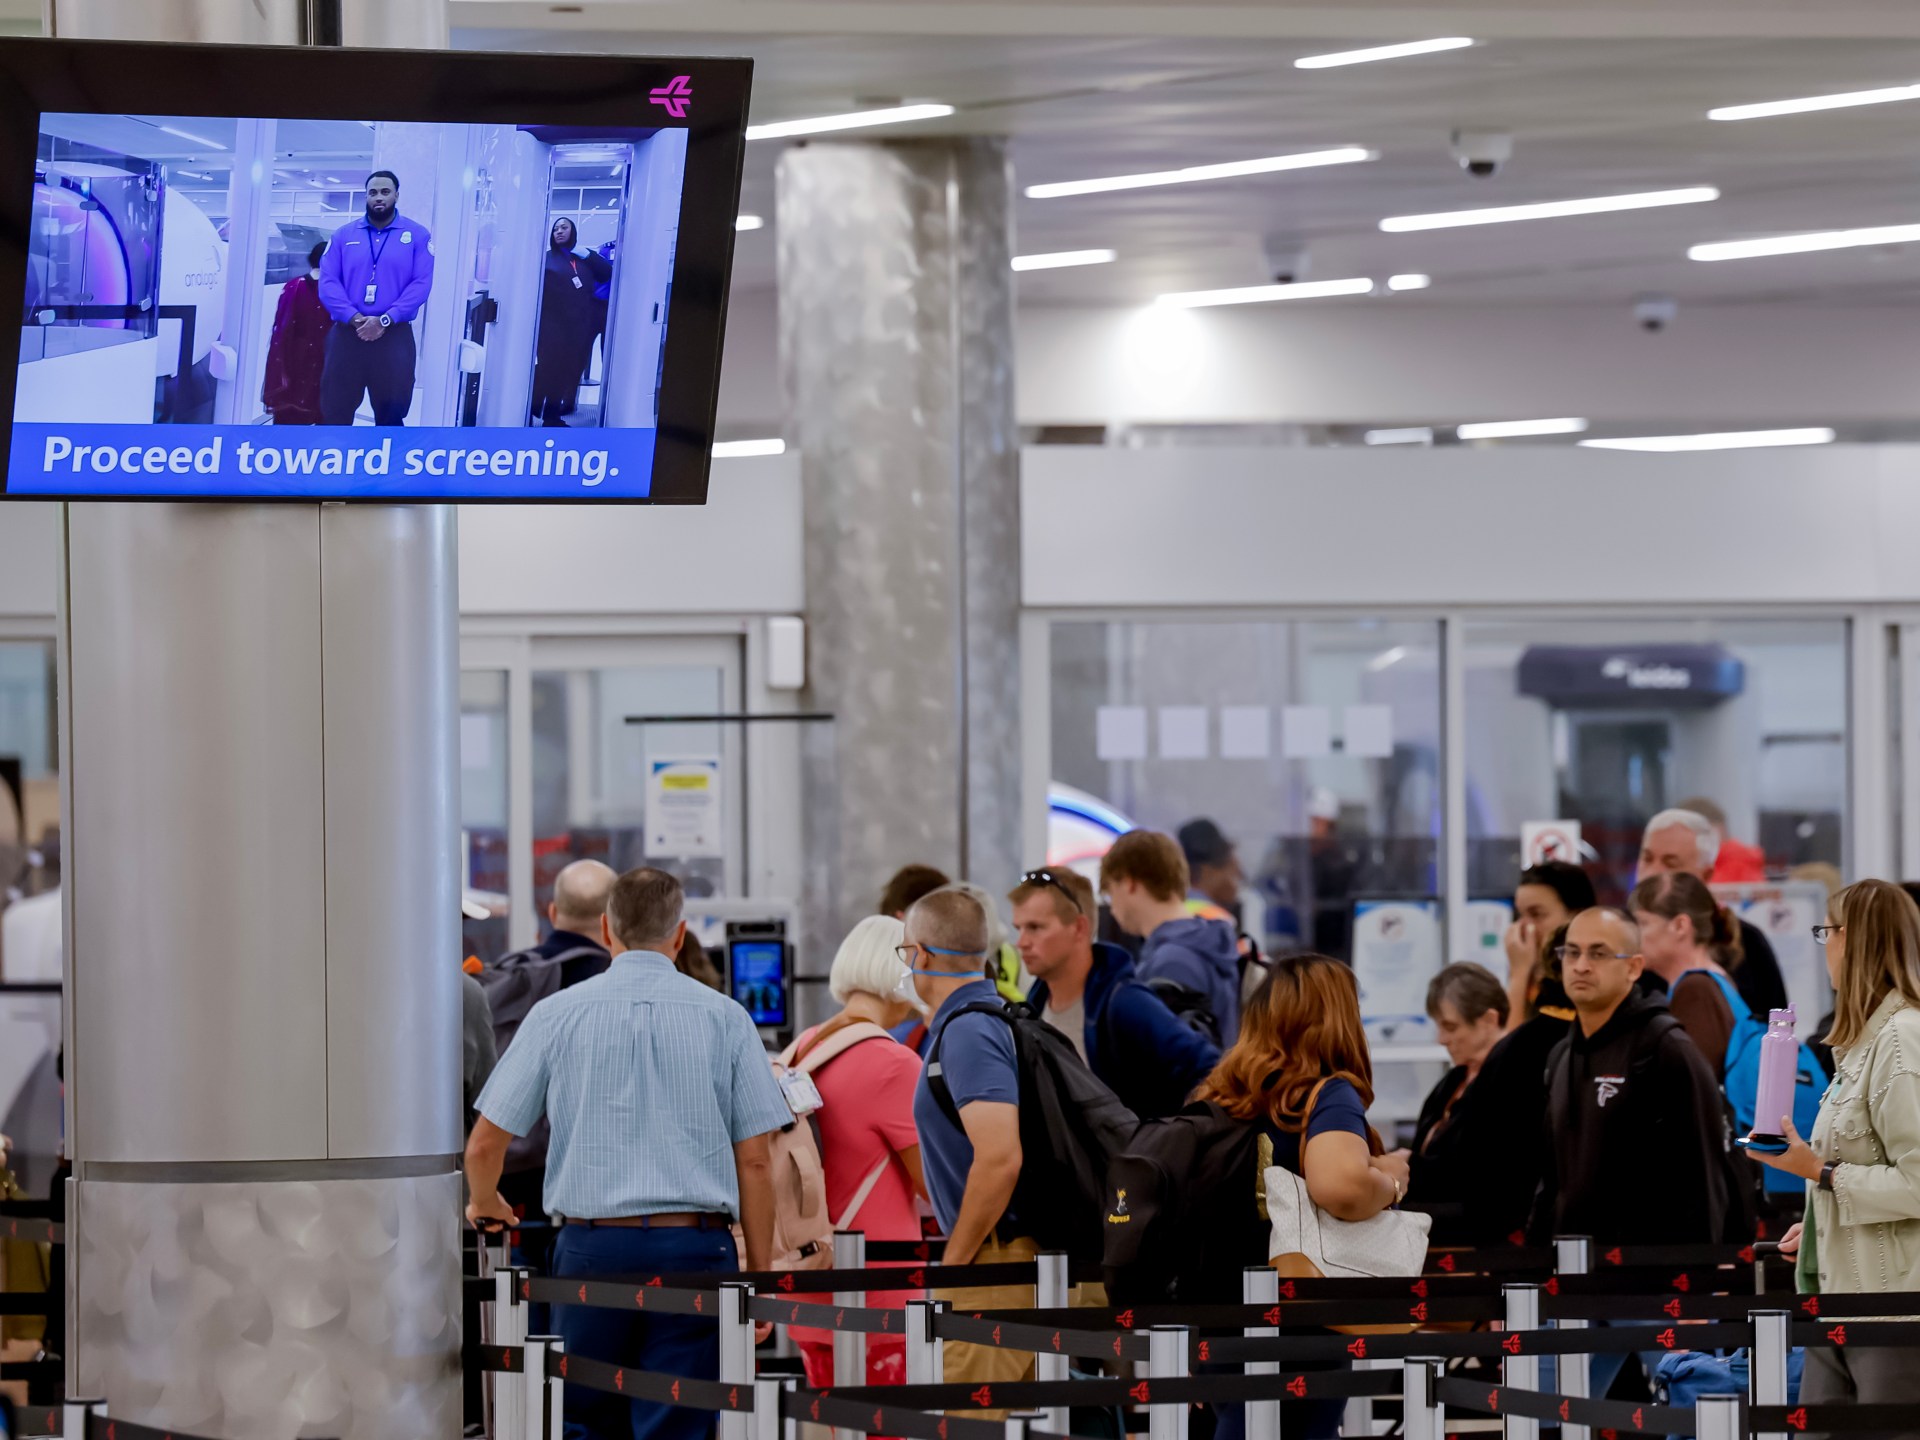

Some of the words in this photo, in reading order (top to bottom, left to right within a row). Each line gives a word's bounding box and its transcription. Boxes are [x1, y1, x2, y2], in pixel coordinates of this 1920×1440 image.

[43, 436, 222, 474] Proceed
[236, 438, 391, 475] toward
[403, 439, 620, 487] screening.
